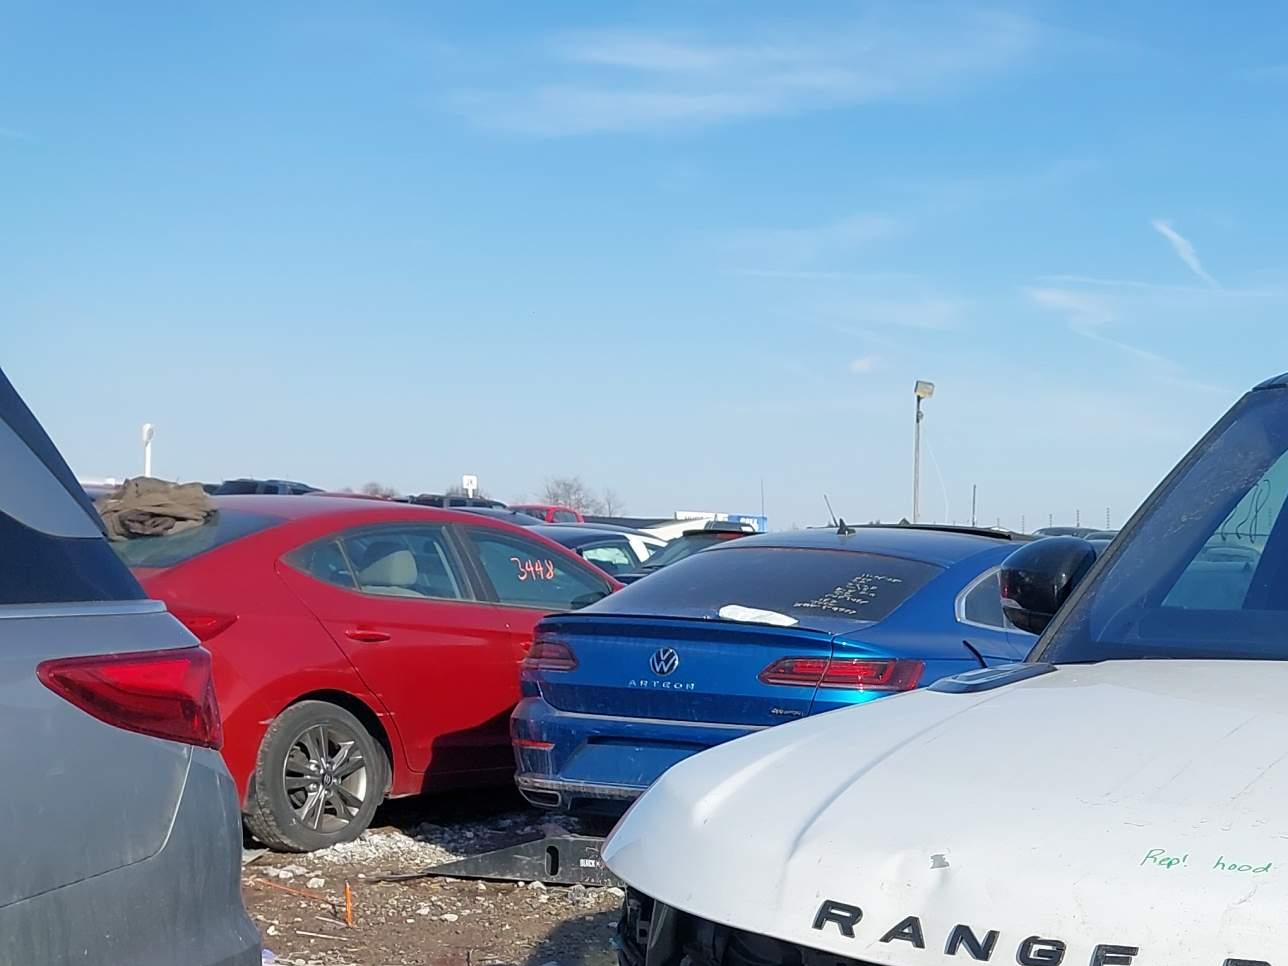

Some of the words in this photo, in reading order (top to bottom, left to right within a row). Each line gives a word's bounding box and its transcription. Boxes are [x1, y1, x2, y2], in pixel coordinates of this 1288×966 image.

[510, 557, 554, 581] 3448
[628, 680, 695, 690] ARTEON
[1213, 855, 1273, 873] hood
